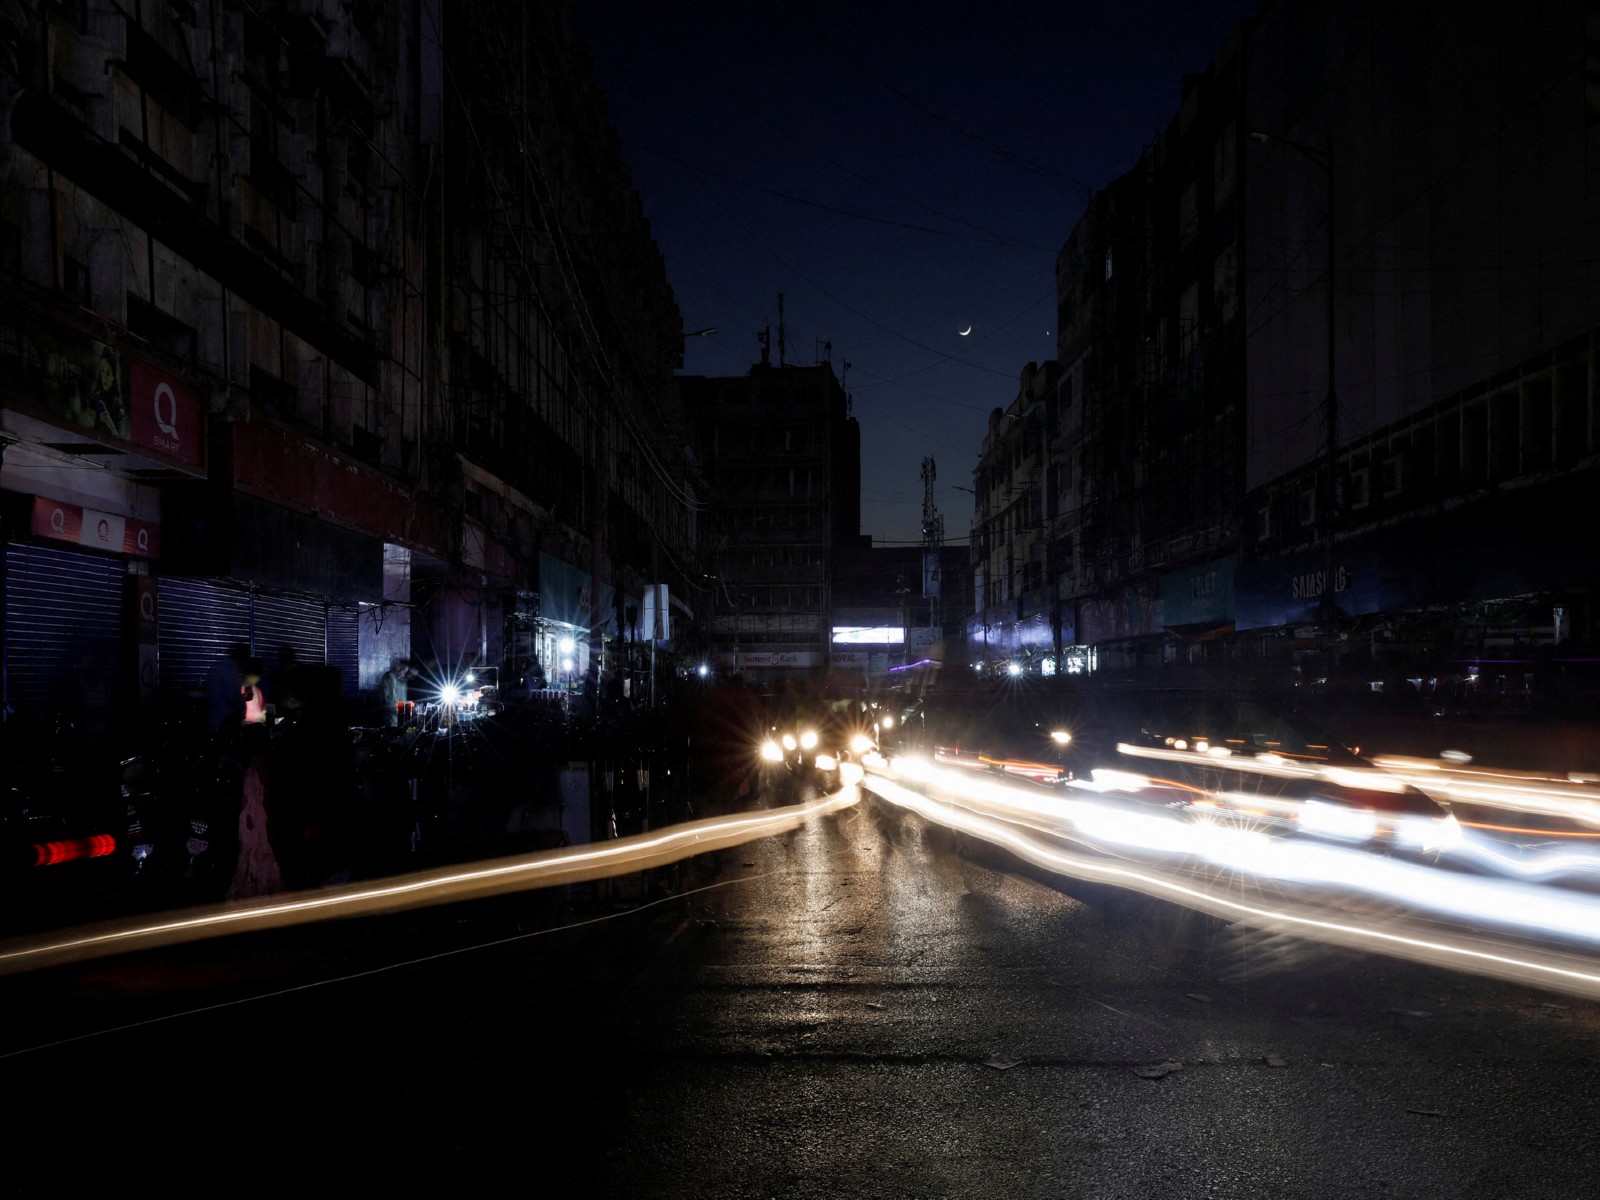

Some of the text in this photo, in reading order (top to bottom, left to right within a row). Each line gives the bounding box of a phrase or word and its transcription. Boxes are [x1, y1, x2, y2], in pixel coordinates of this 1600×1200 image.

[153, 382, 179, 440] Q
[153, 434, 180, 454] SMART
[50, 507, 65, 533] Q
[137, 528, 149, 552] Q
[1292, 565, 1346, 599] SAMSG
[140, 591, 155, 621] Q
[744, 654, 771, 663] Summit
[780, 655, 798, 663] Bank
